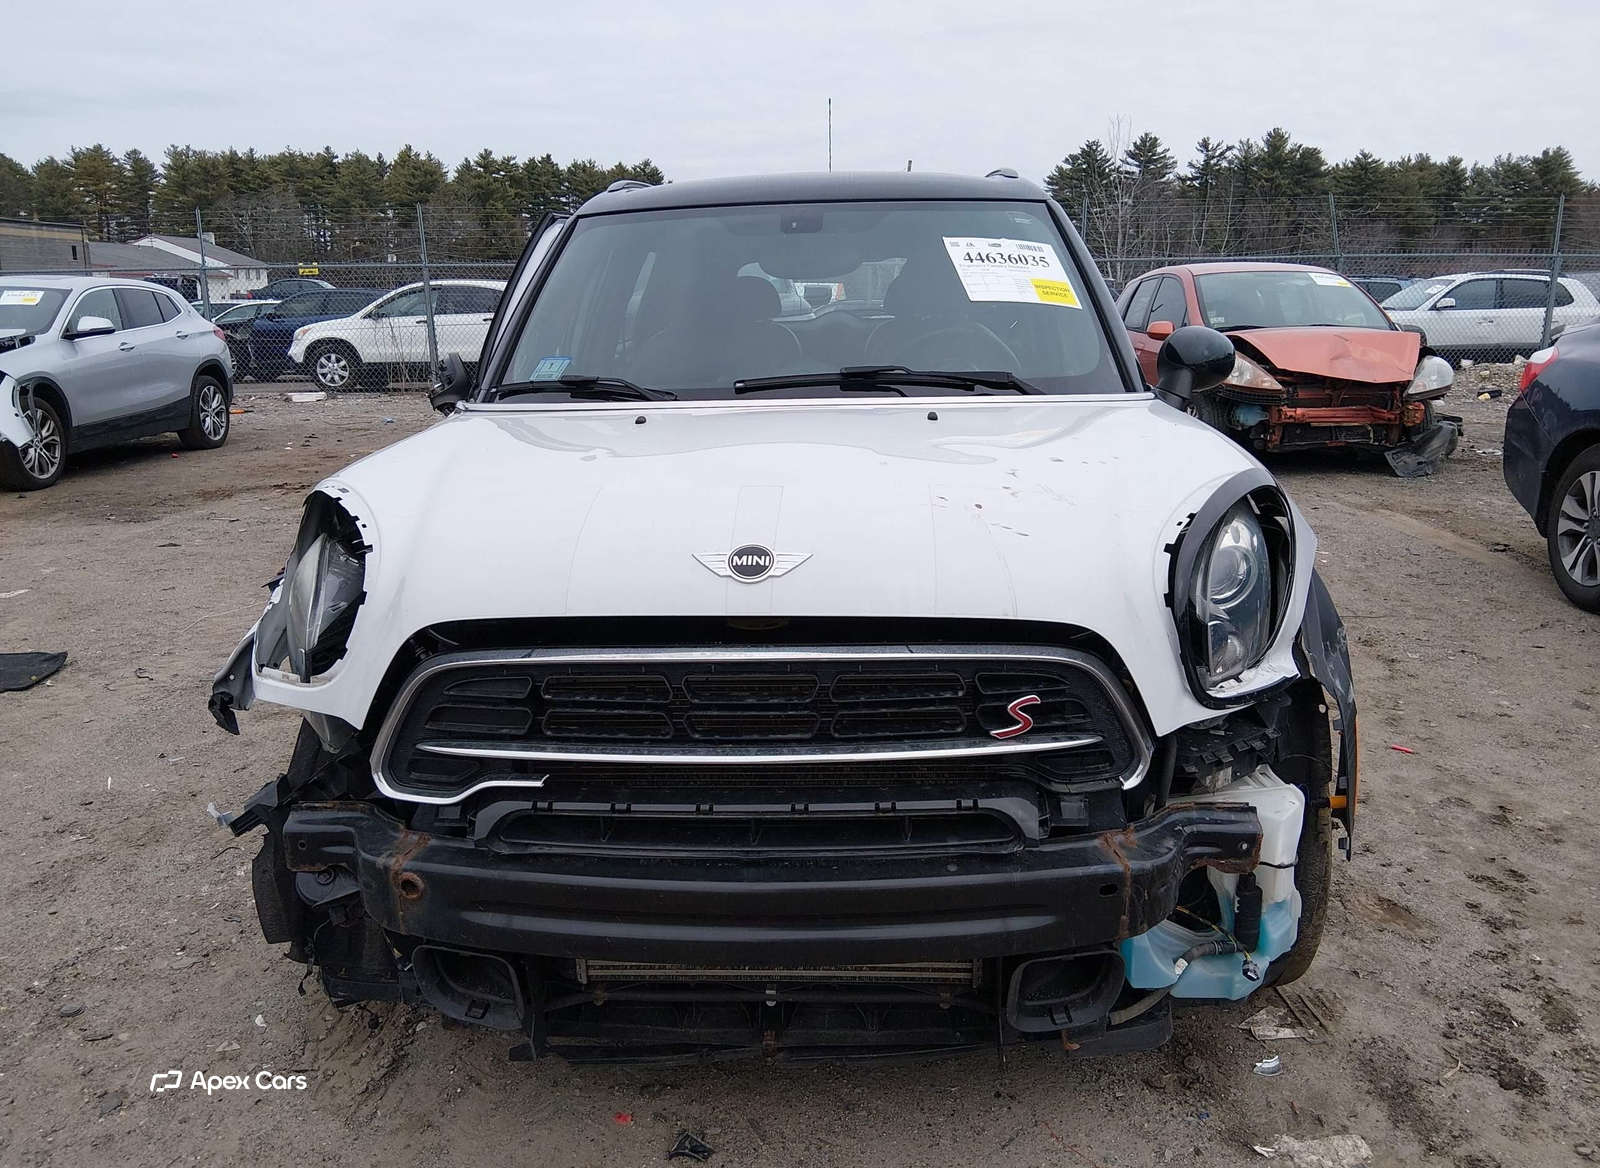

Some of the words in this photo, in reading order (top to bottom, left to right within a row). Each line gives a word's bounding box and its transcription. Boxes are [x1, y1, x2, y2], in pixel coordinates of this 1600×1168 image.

[963, 252, 1050, 268] 44636035
[1034, 284, 1070, 293] INSPECTION
[1042, 290, 1069, 299] SERVICE
[732, 555, 770, 566] MINI
[990, 694, 1041, 739] S
